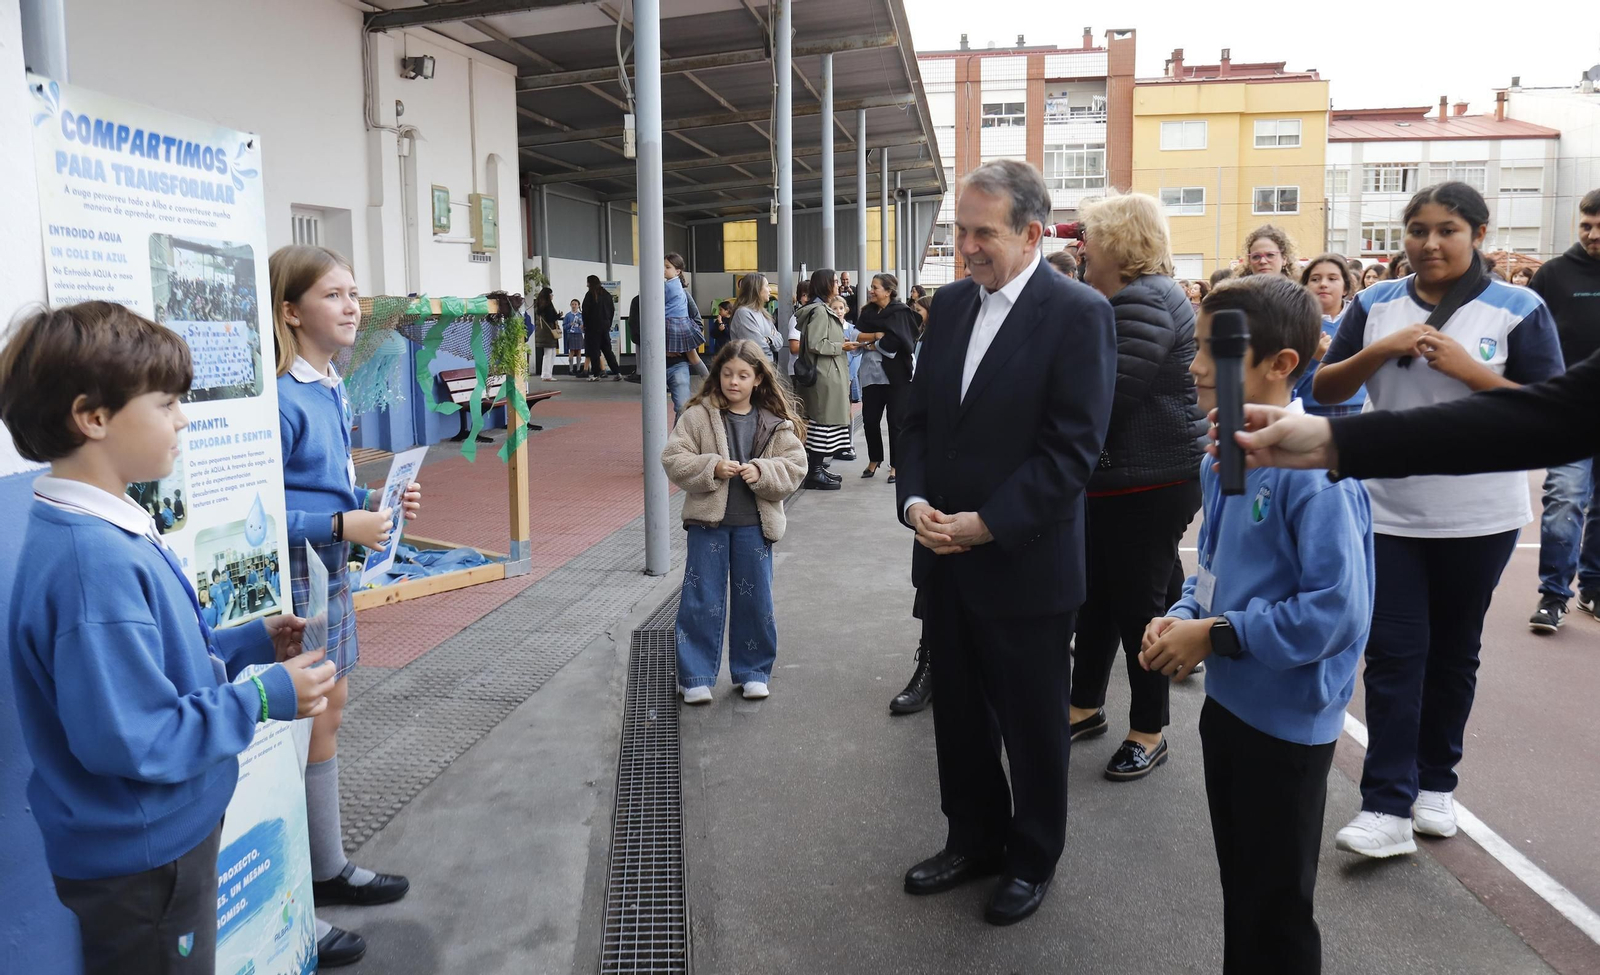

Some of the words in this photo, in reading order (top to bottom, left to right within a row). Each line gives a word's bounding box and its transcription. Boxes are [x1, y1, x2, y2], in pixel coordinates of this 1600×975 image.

[61, 110, 228, 175] COMPARTIMOS
[55, 150, 107, 183] PARA
[111, 162, 236, 205] TRANSFORMAR
[64, 184, 70, 194] A
[72, 188, 92, 200] auga
[93, 191, 126, 204] percorreu
[128, 197, 143, 207] todo
[152, 200, 167, 210] Alba
[175, 205, 212, 217] converteuse
[213, 210, 231, 219] nunha
[83, 203, 112, 214] maneira
[113, 206, 123, 215] de
[124, 208, 158, 221] aprender,
[158, 213, 175, 222] crear
[48, 224, 95, 240] ENTROIDO
[98, 231, 122, 243] AQUA
[50, 246, 63, 257] UN
[65, 248, 90, 260] COLE
[92, 250, 104, 261] EN
[106, 252, 128, 263] AZUL
[52, 266, 62, 275] No
[63, 267, 91, 277] Entroido
[93, 269, 112, 279] AQUA
[54, 279, 76, 290] colexio
[77, 281, 105, 292] encheuse
[106, 283, 115, 292] de
[187, 417, 229, 433] INFANTIL
[189, 435, 232, 451] EXPLORAR
[235, 433, 240, 444] E
[242, 429, 272, 442] SENTIR
[208, 456, 231, 466] pequenos
[247, 450, 265, 459] forman
[190, 470, 203, 479] parte
[192, 487, 219, 498] descubrimos
[230, 880, 242, 898] UN
[243, 858, 271, 889] MESMO
